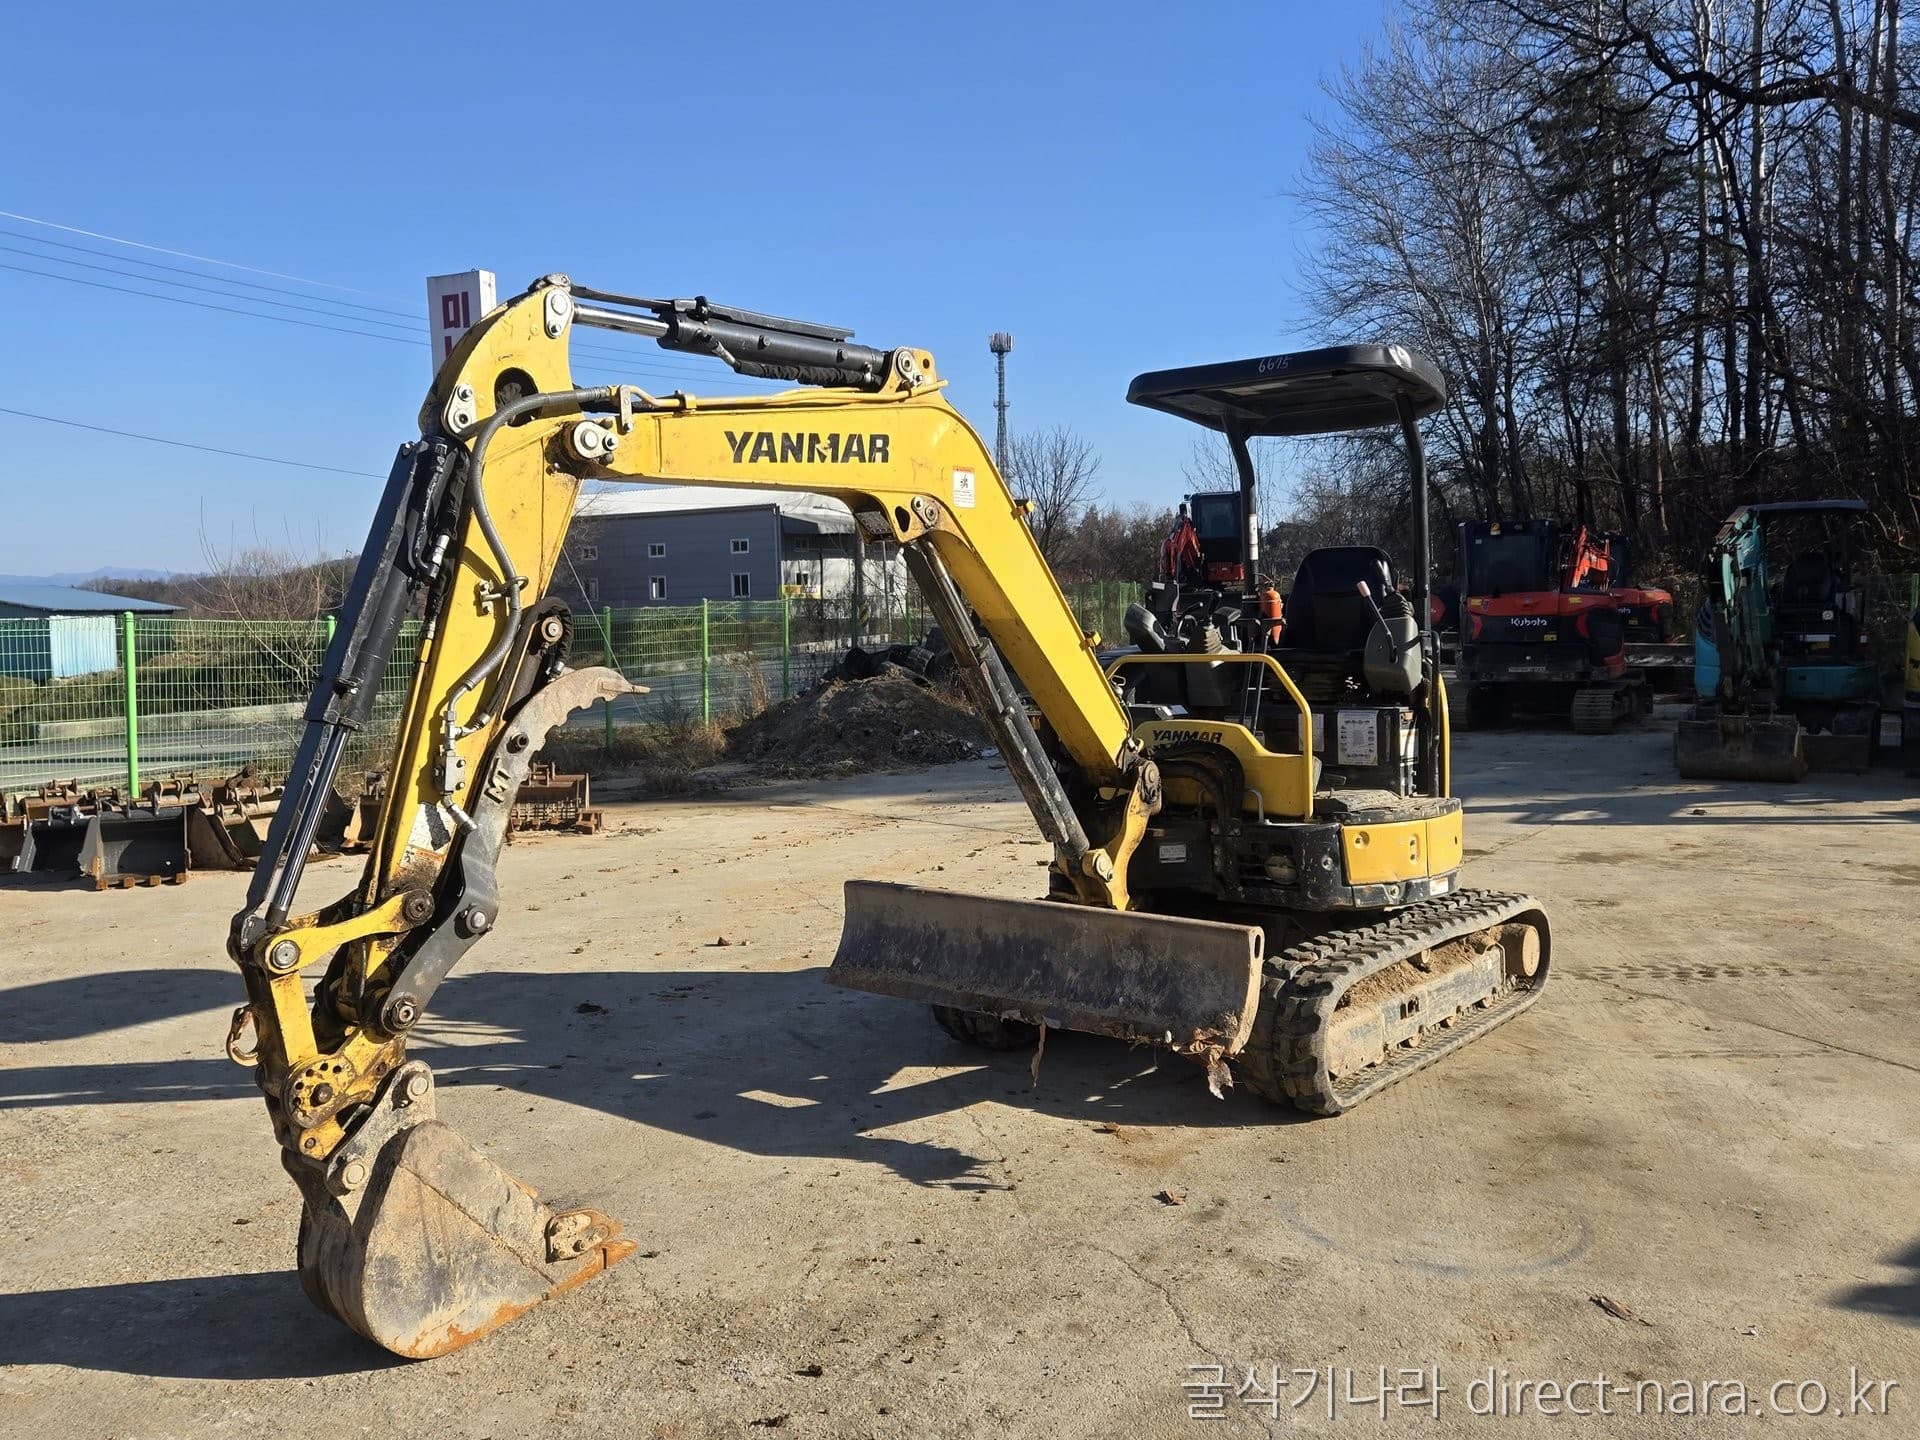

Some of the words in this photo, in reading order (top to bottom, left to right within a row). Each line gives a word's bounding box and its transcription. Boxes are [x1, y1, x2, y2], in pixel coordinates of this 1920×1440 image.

[724, 431, 890, 464] YANMAR
[1510, 617, 1548, 627] Kubota
[1152, 729, 1223, 743] YANMAR
